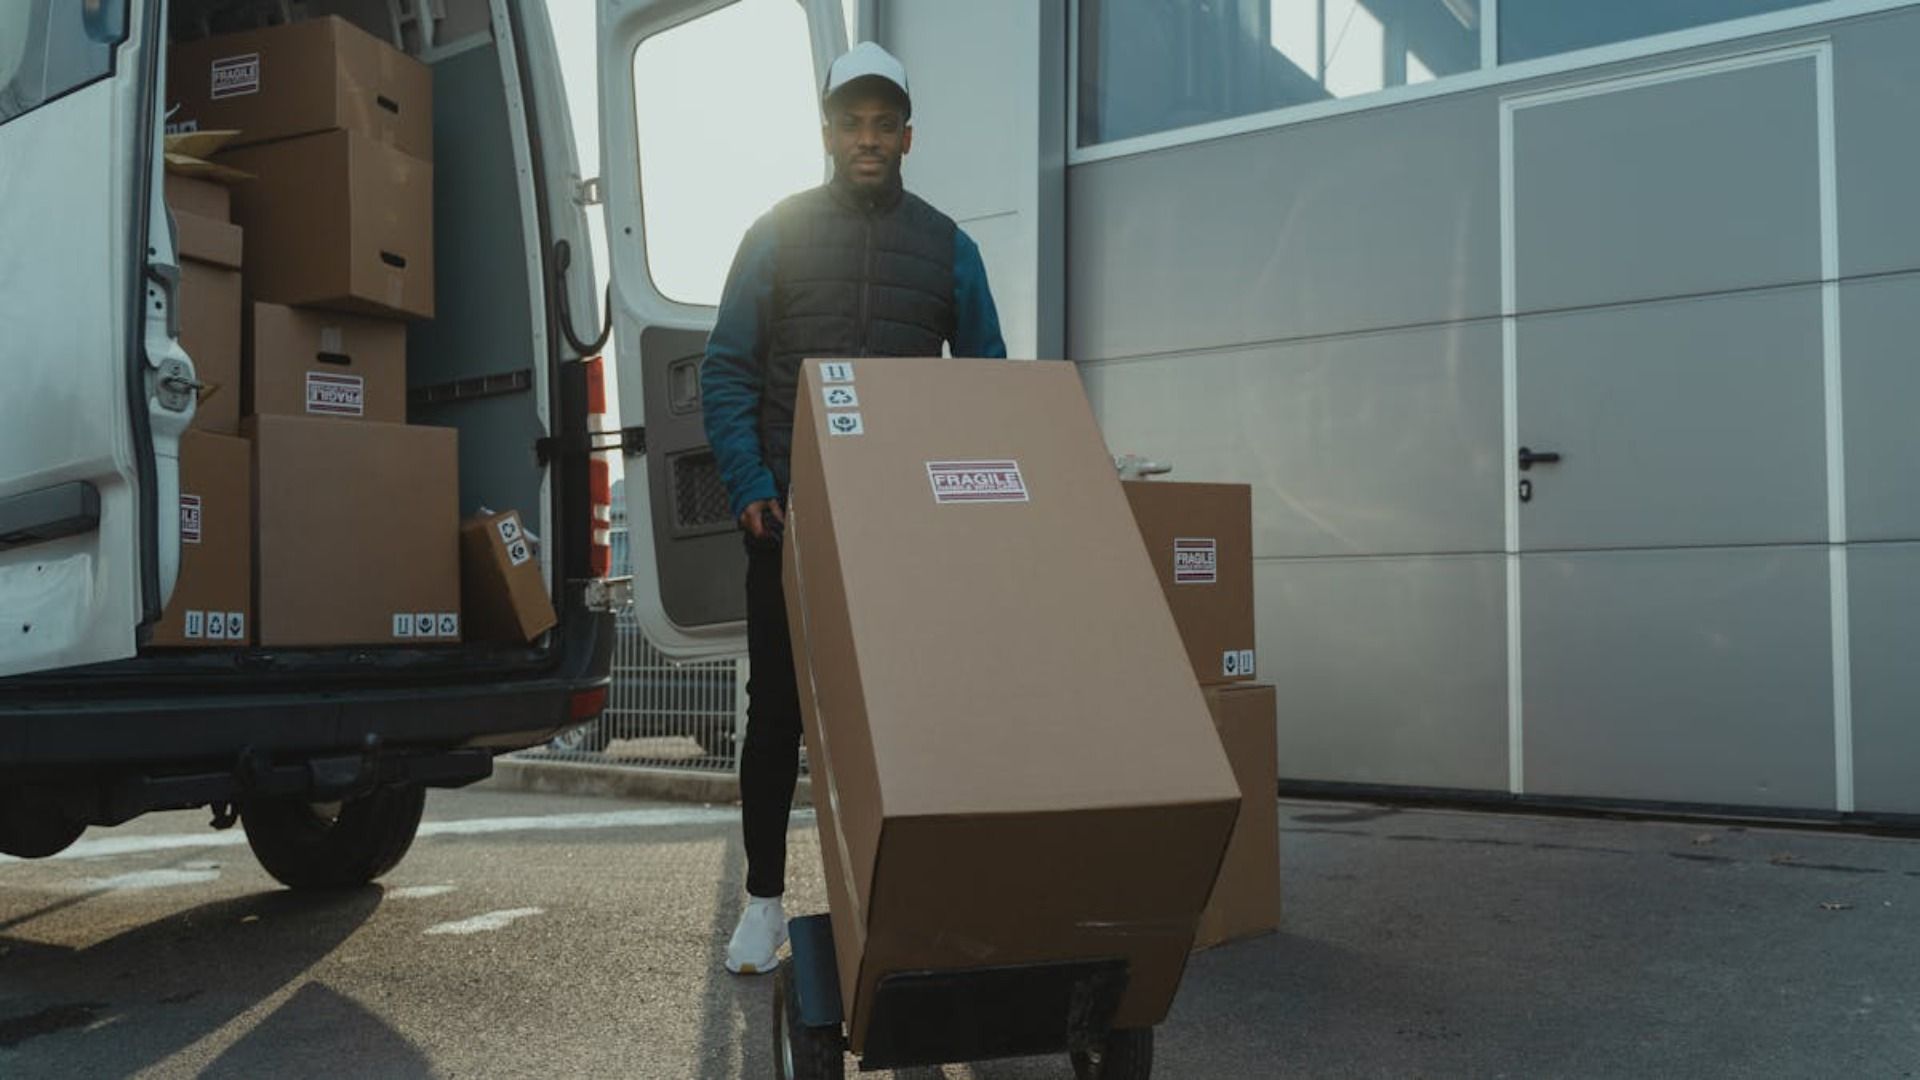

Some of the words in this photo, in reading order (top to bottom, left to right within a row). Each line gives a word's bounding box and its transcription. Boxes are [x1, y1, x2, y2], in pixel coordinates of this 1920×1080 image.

[214, 66, 257, 84] FRAGILE
[310, 387, 361, 404] FRAGILE
[933, 473, 1018, 487] FRAGILE
[1177, 551, 1214, 565] FRAGILE
